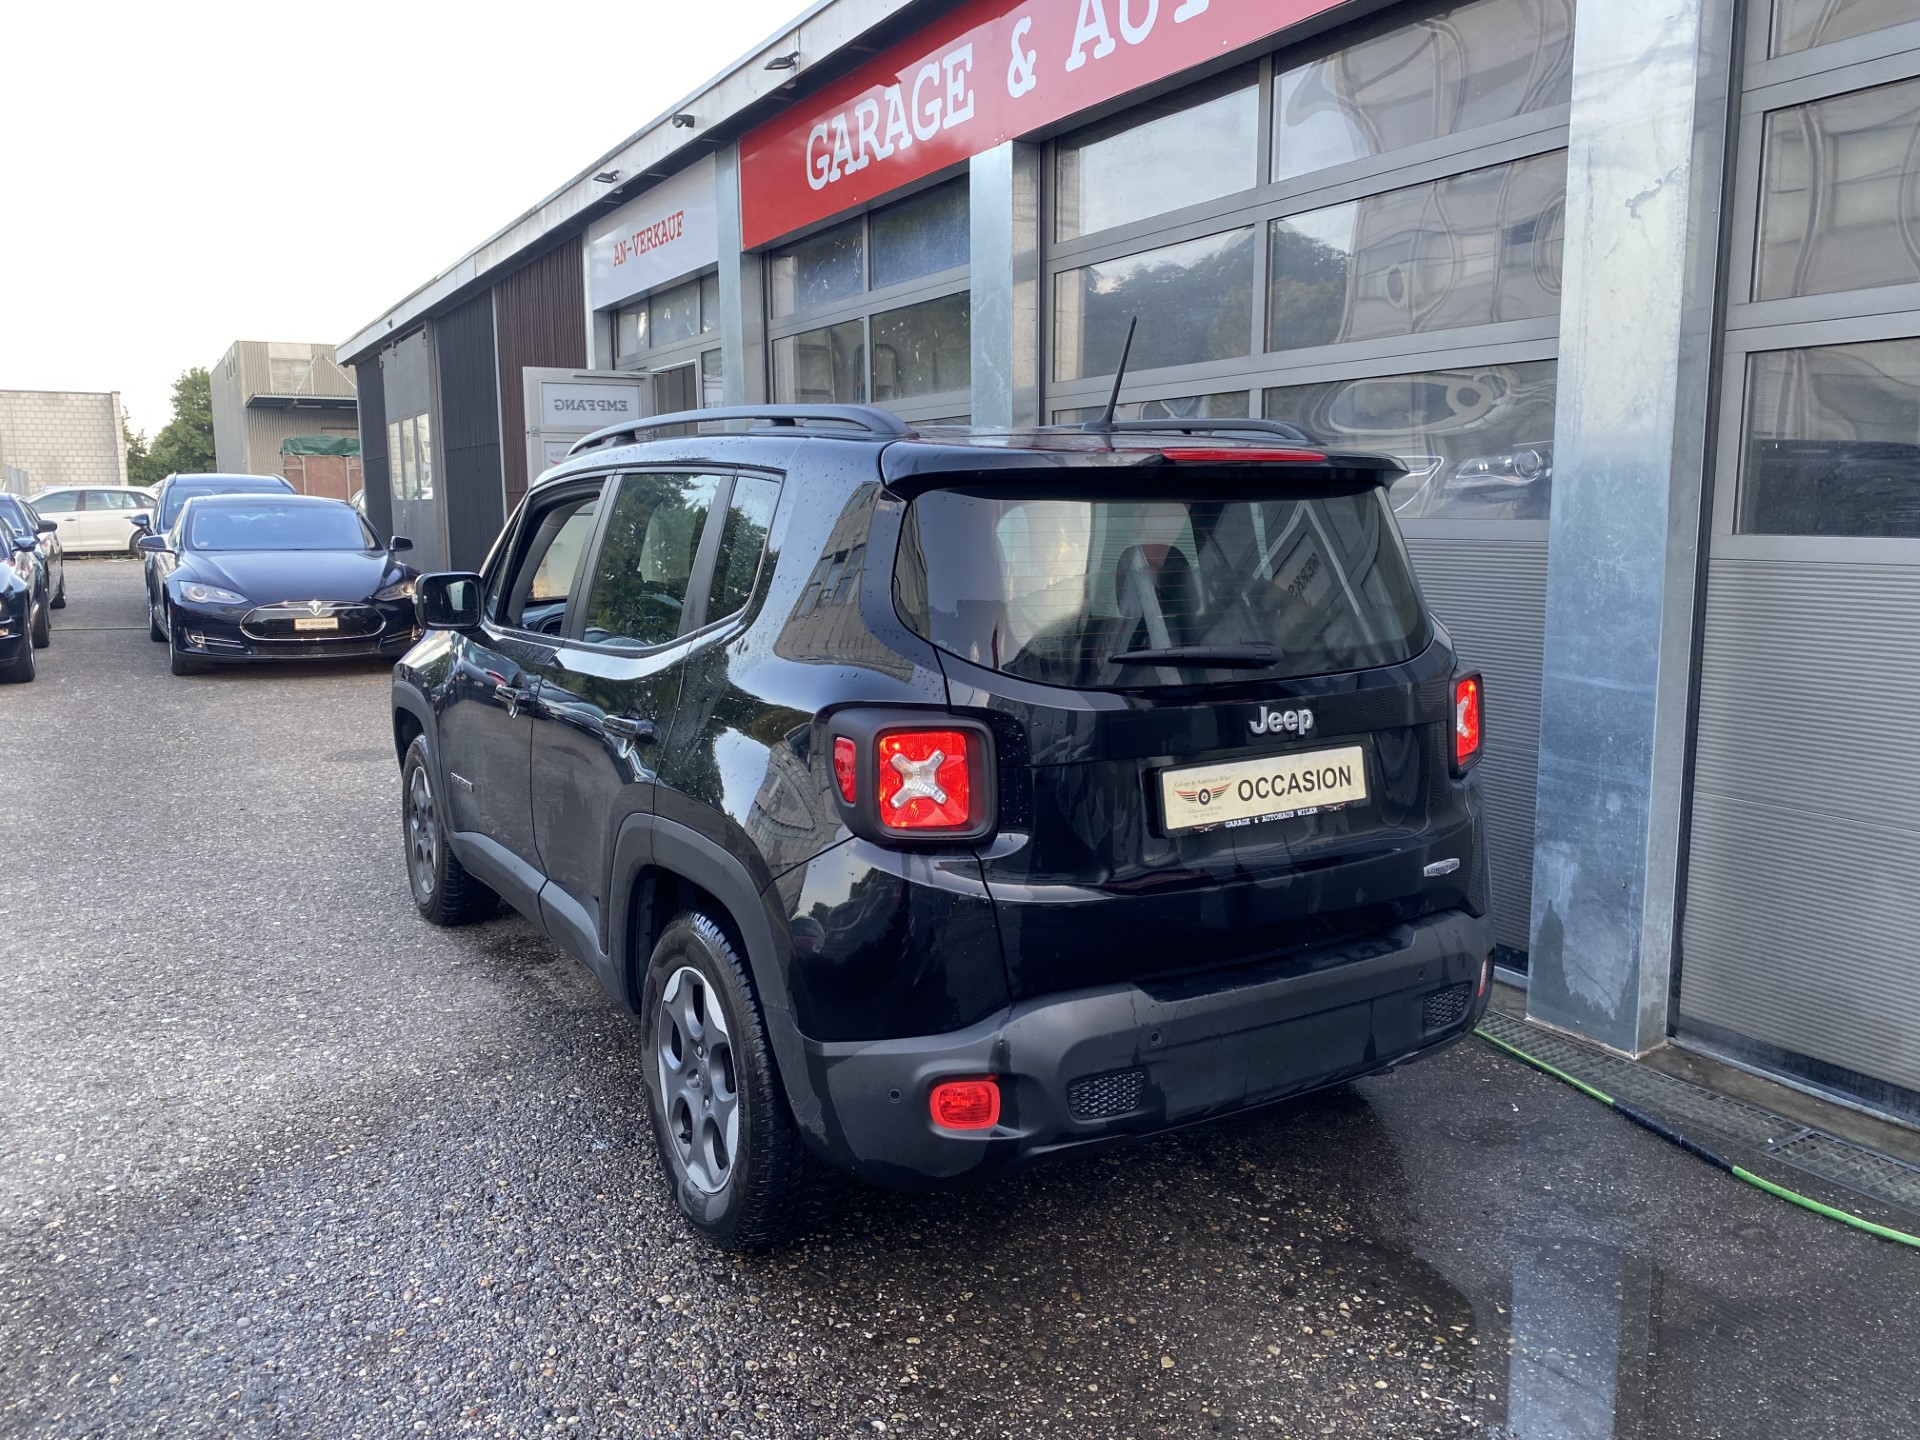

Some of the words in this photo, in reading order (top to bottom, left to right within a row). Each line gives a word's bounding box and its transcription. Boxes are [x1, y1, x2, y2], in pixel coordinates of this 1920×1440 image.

[806, 42, 975, 190] GARAGE
[1007, 16, 1037, 98] &
[1064, 0, 1209, 72] AU
[613, 210, 684, 267] AN-VERKAUF
[1249, 706, 1314, 735] Jeep
[1238, 765, 1352, 802] OCCASION
[1225, 818, 1251, 828] GARAGE
[1261, 810, 1294, 823] AUTOHAUS
[1297, 807, 1318, 816] WILER
